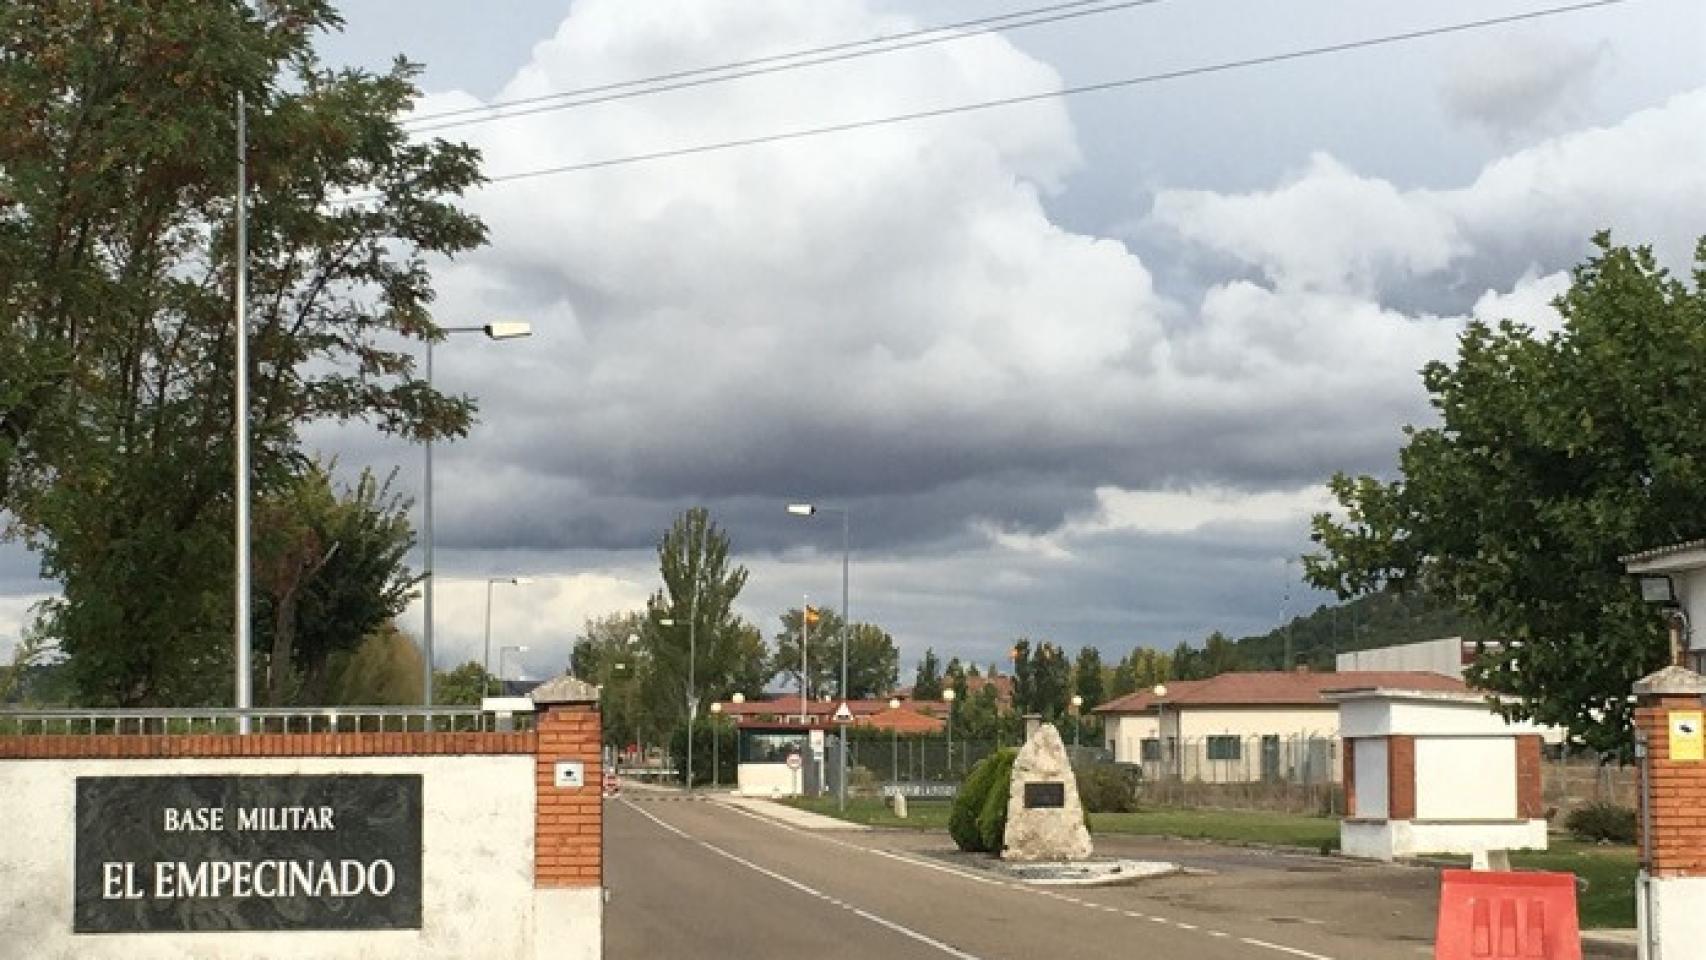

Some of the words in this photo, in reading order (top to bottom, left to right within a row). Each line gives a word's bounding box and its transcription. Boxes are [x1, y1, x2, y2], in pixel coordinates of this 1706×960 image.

[164, 807, 224, 831] BASE
[237, 806, 336, 831] MILITAR
[102, 861, 145, 899] EL
[154, 859, 396, 898] EMPECINADO
